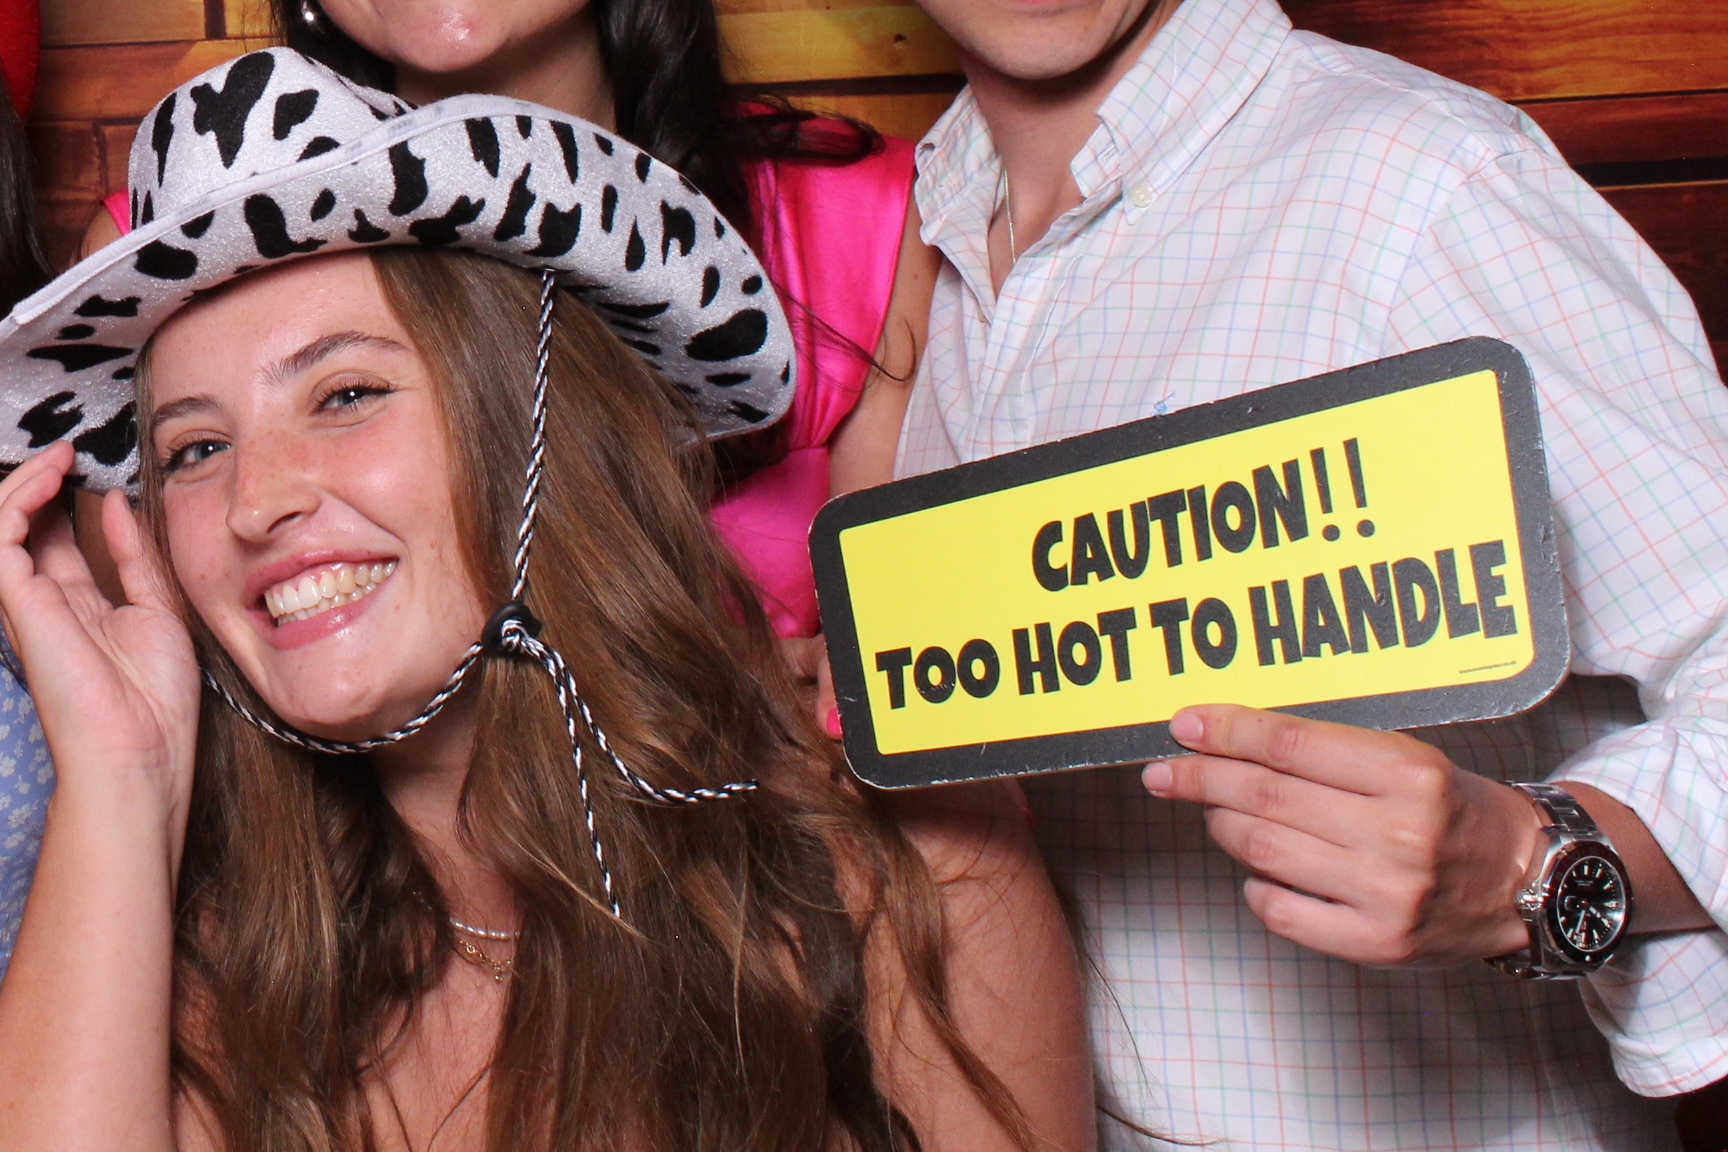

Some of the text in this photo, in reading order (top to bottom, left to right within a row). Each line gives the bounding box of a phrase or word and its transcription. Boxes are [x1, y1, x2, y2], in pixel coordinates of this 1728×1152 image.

[1032, 438, 1375, 592] CAUTION!!
[875, 540, 1517, 710] TOO HOT TO HANDLE
